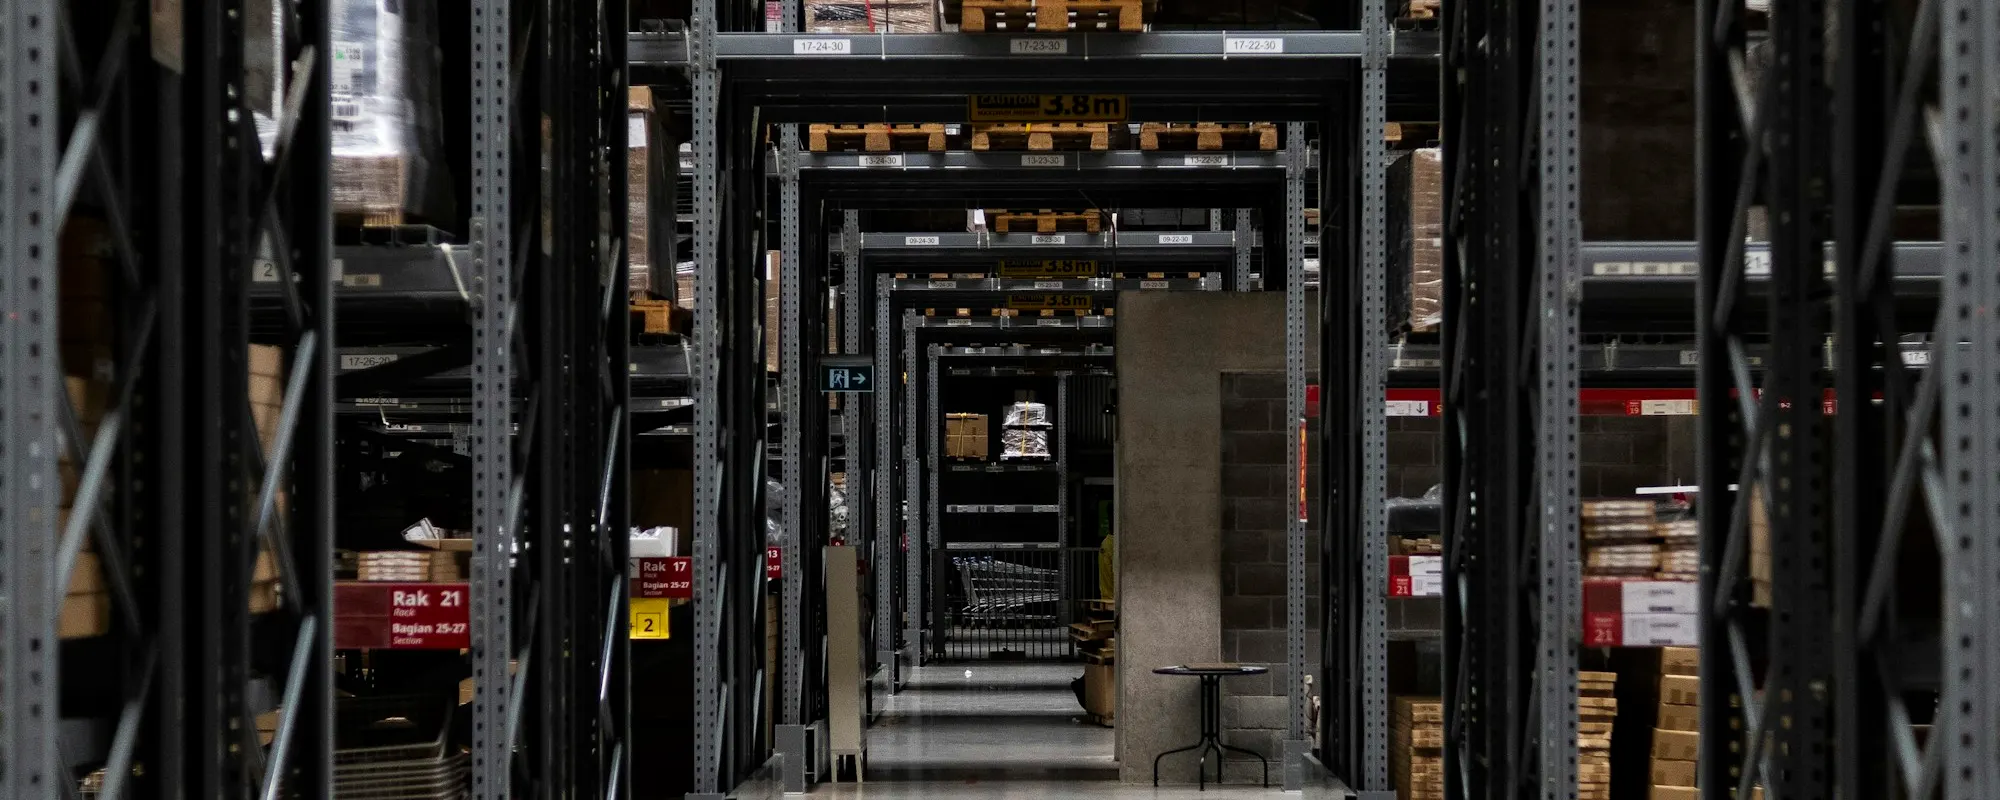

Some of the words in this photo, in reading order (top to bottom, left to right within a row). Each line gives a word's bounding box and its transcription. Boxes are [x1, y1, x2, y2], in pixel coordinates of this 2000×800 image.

[801, 41, 844, 51] 17-24-30
[1018, 41, 1061, 51] 17-23-30
[1233, 40, 1276, 50] 17-22-30
[864, 156, 897, 165] 13-24-30
[1027, 156, 1060, 165] 13-23-30
[1191, 156, 1223, 164] 13-22-30
[643, 561, 667, 573] Rak
[672, 561, 688, 573] 17
[642, 581, 669, 591] Bagian
[669, 581, 690, 589] 25-27
[1396, 585, 1409, 595] 21
[392, 588, 431, 608] Rak
[439, 589, 462, 608] 21
[392, 607, 417, 618] Rack
[391, 622, 433, 637] Bagian
[435, 622, 468, 635] 25-27
[643, 618, 654, 632] 2
[1593, 628, 1614, 643] 21
